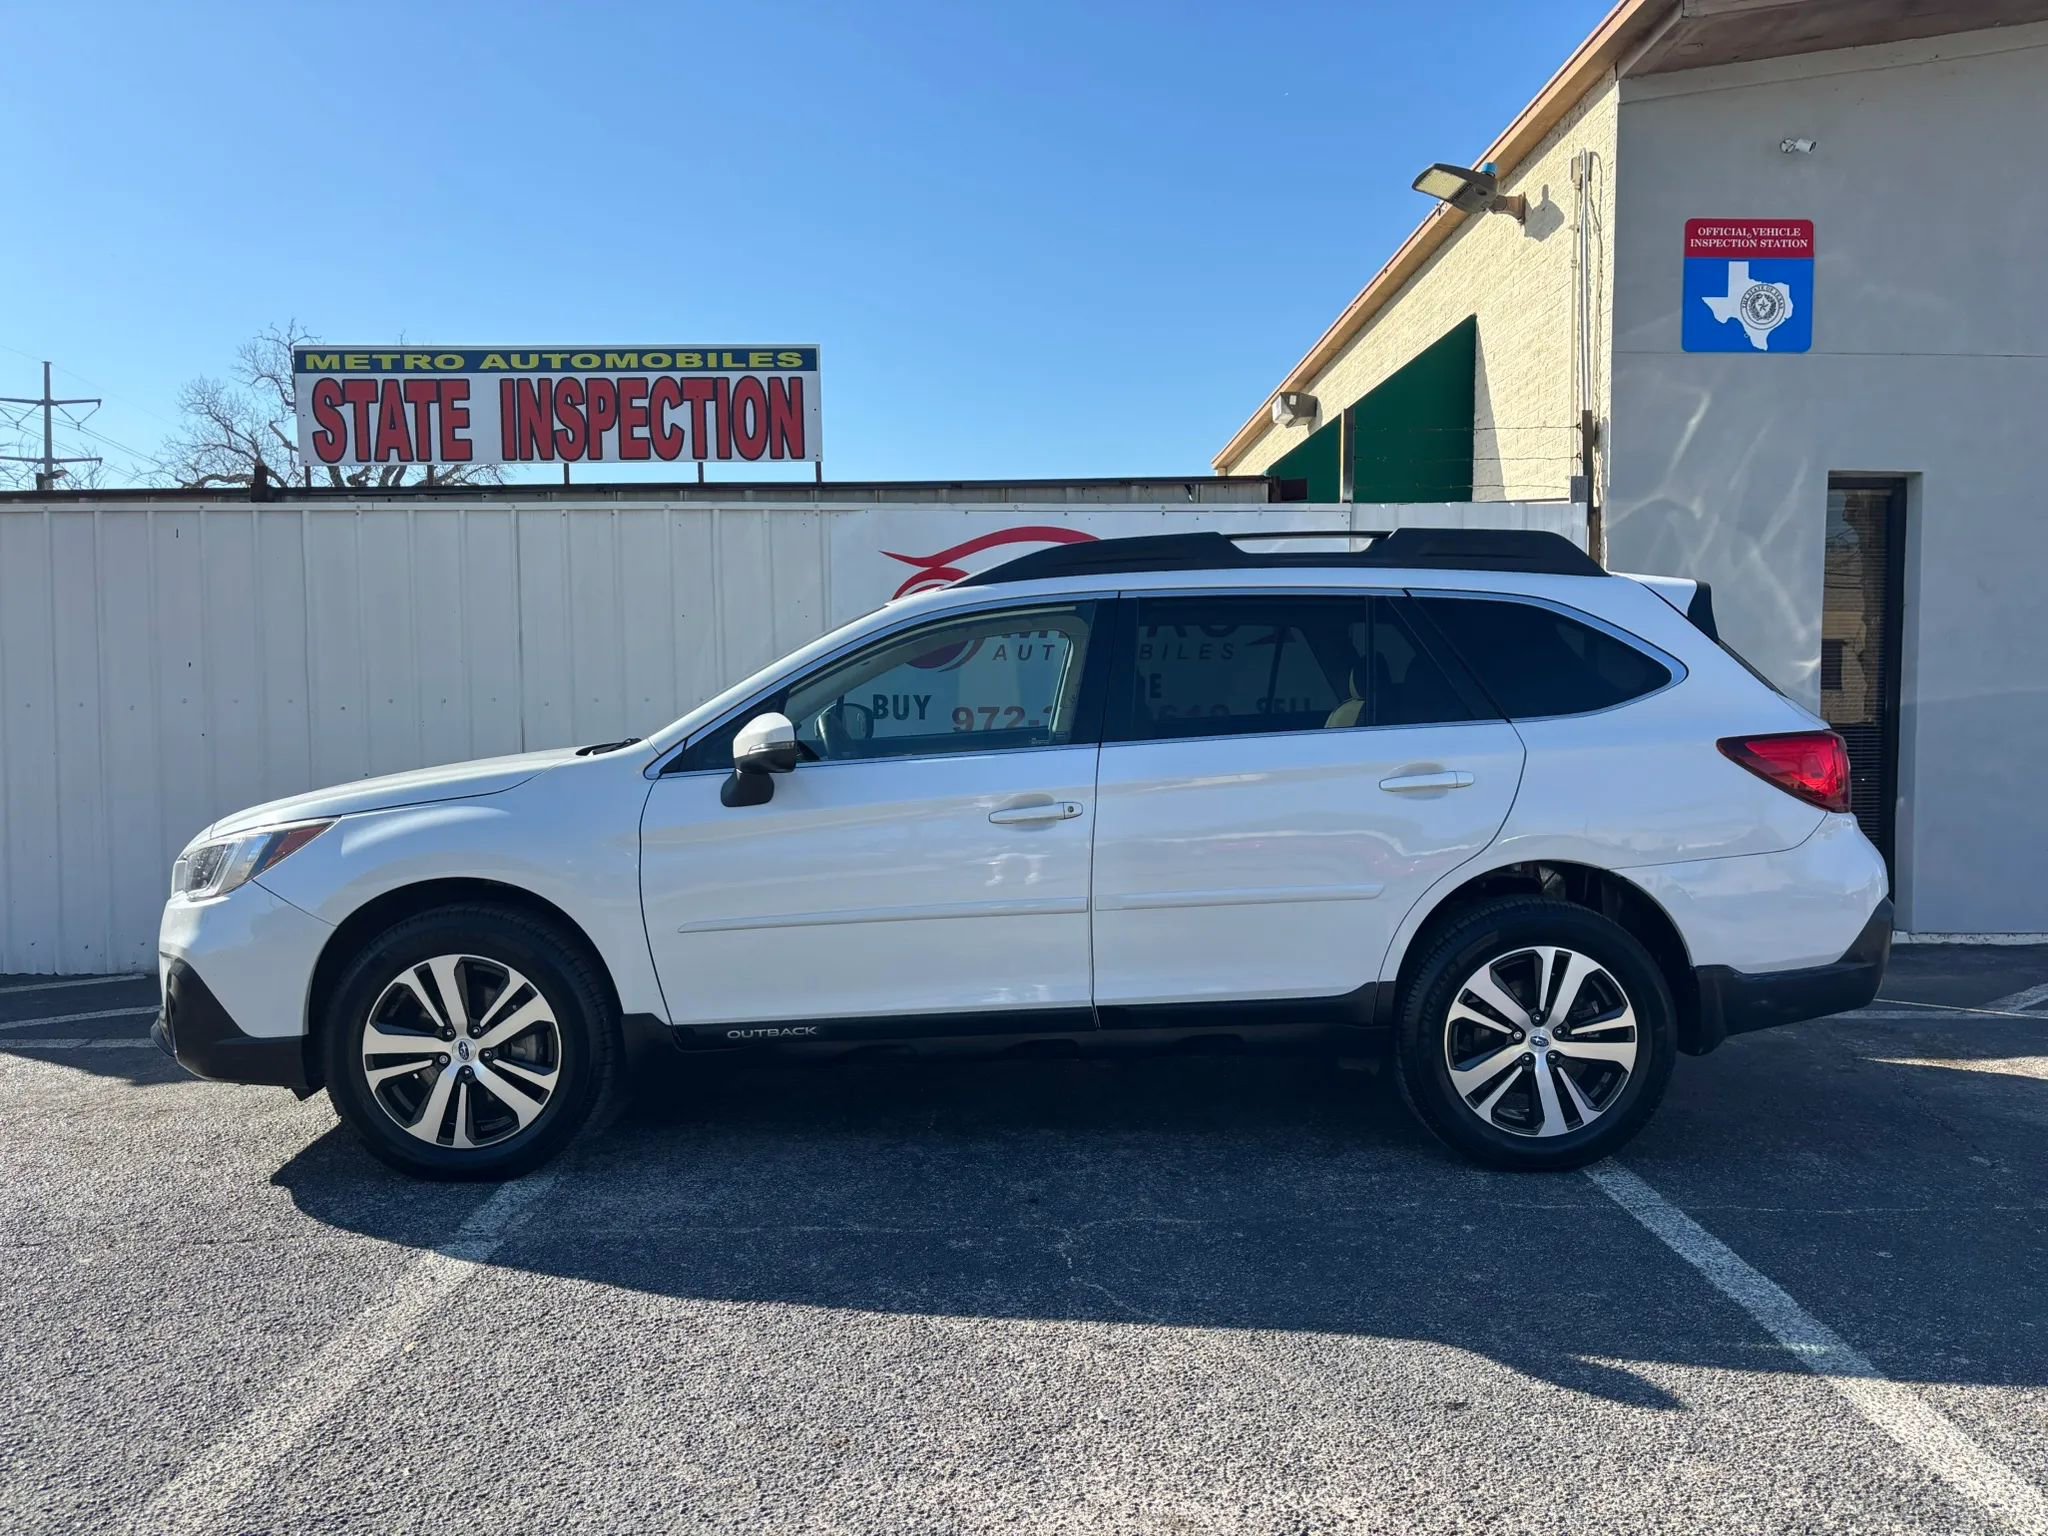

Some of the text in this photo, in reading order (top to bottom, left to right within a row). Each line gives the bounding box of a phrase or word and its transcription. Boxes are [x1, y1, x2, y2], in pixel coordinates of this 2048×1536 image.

[1698, 227, 1801, 236] OFFICIAL VEHICLE
[1690, 239, 1808, 248] INSPECTION STATION
[305, 351, 804, 370] METRO AUTOMOBILES
[312, 375, 805, 463] STATE INSPECTION
[872, 694, 932, 720] BUY
[727, 1026, 817, 1039] OUTBACK
